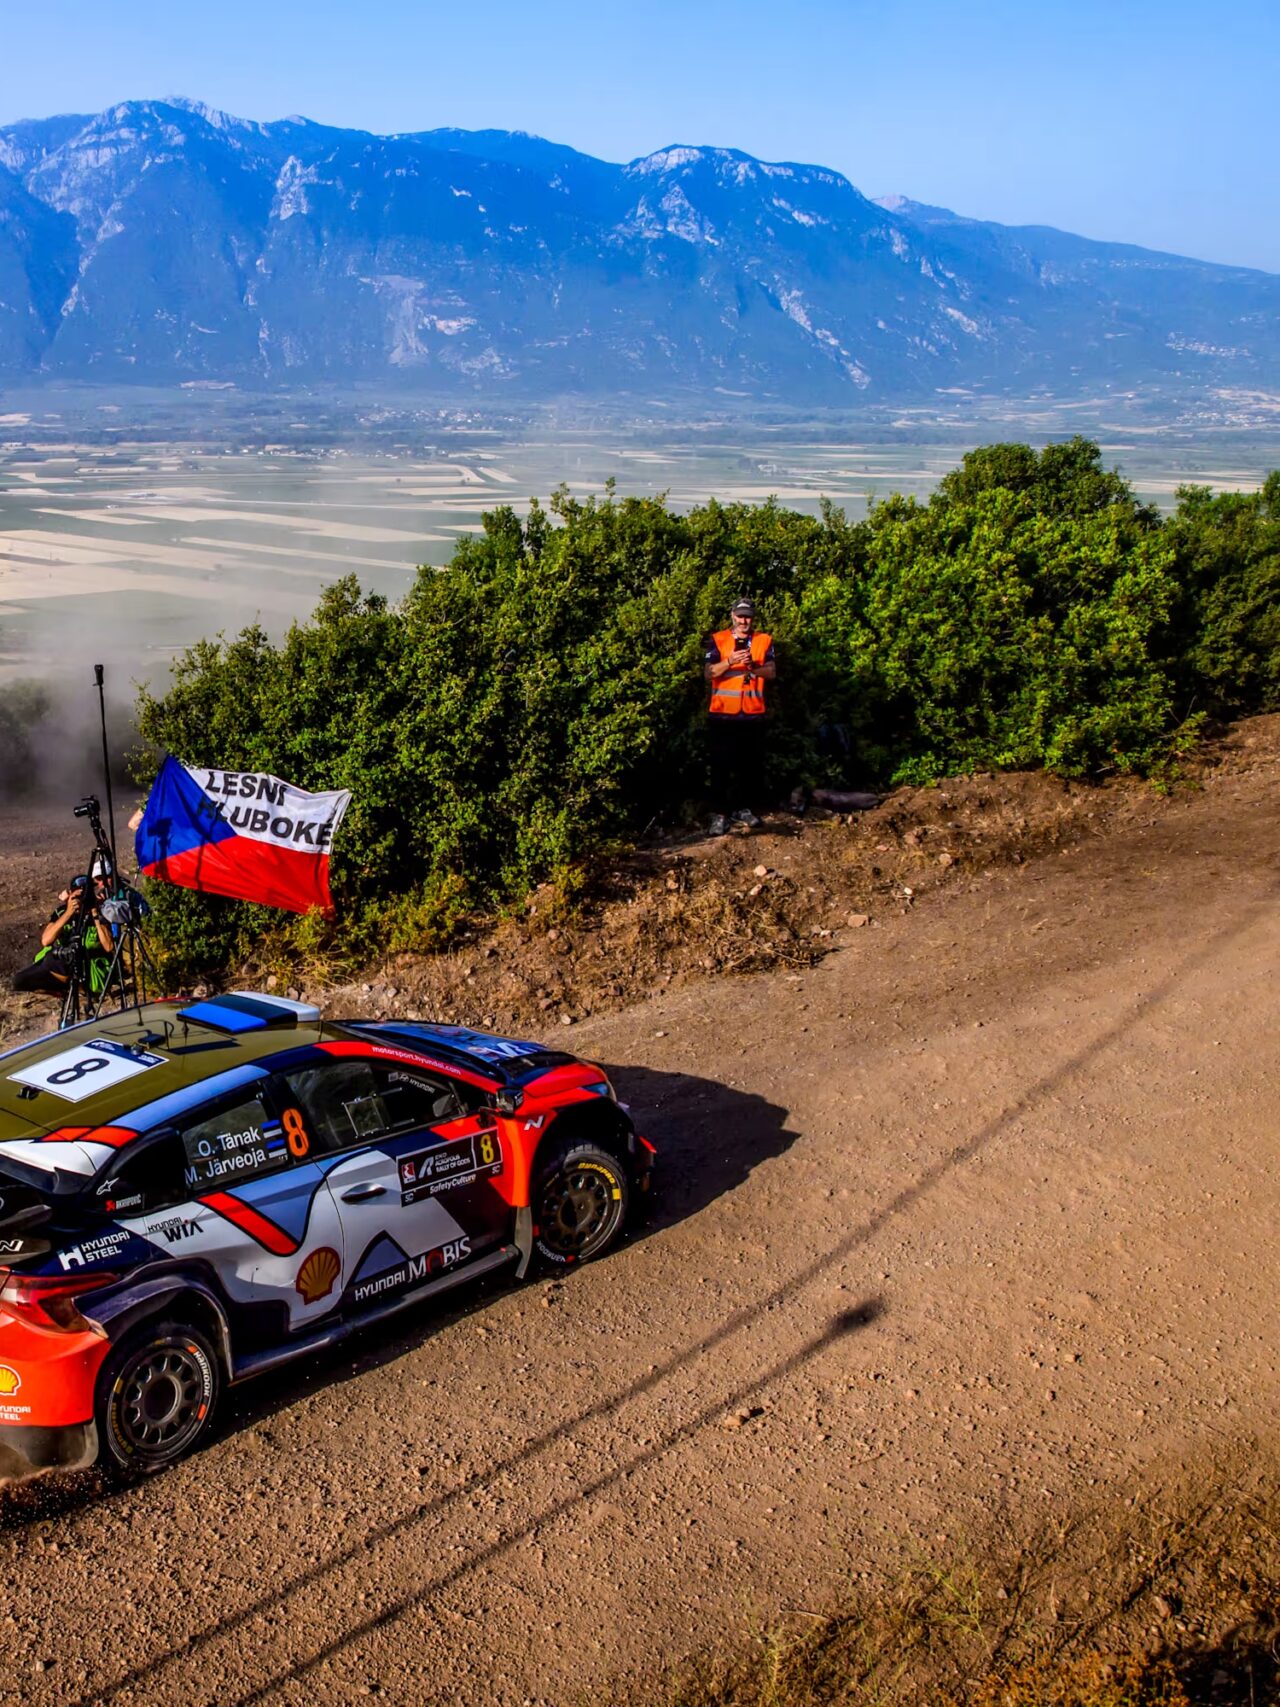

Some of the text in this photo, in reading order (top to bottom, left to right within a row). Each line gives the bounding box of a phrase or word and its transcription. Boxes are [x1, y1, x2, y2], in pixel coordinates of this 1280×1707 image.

[46, 1058, 110, 1085] 8
[372, 1046, 461, 1075] motorsport.hyundai.com
[409, 1078, 436, 1094] HYUNDAI
[198, 1126, 262, 1157] O. Tänak
[282, 1108, 310, 1157] 8
[480, 1134, 495, 1164] 8
[184, 1147, 267, 1186] M. Järveoja
[436, 1164, 450, 1173] RALLY
[450, 1161, 458, 1169] OF
[429, 1173, 477, 1194] SafetyCulture
[148, 1216, 182, 1233] HYUNDAI
[81, 1230, 131, 1253] HYUNDAI
[85, 1245, 122, 1262] STEEL
[354, 1236, 472, 1301] HYUNDAI MOBIS
